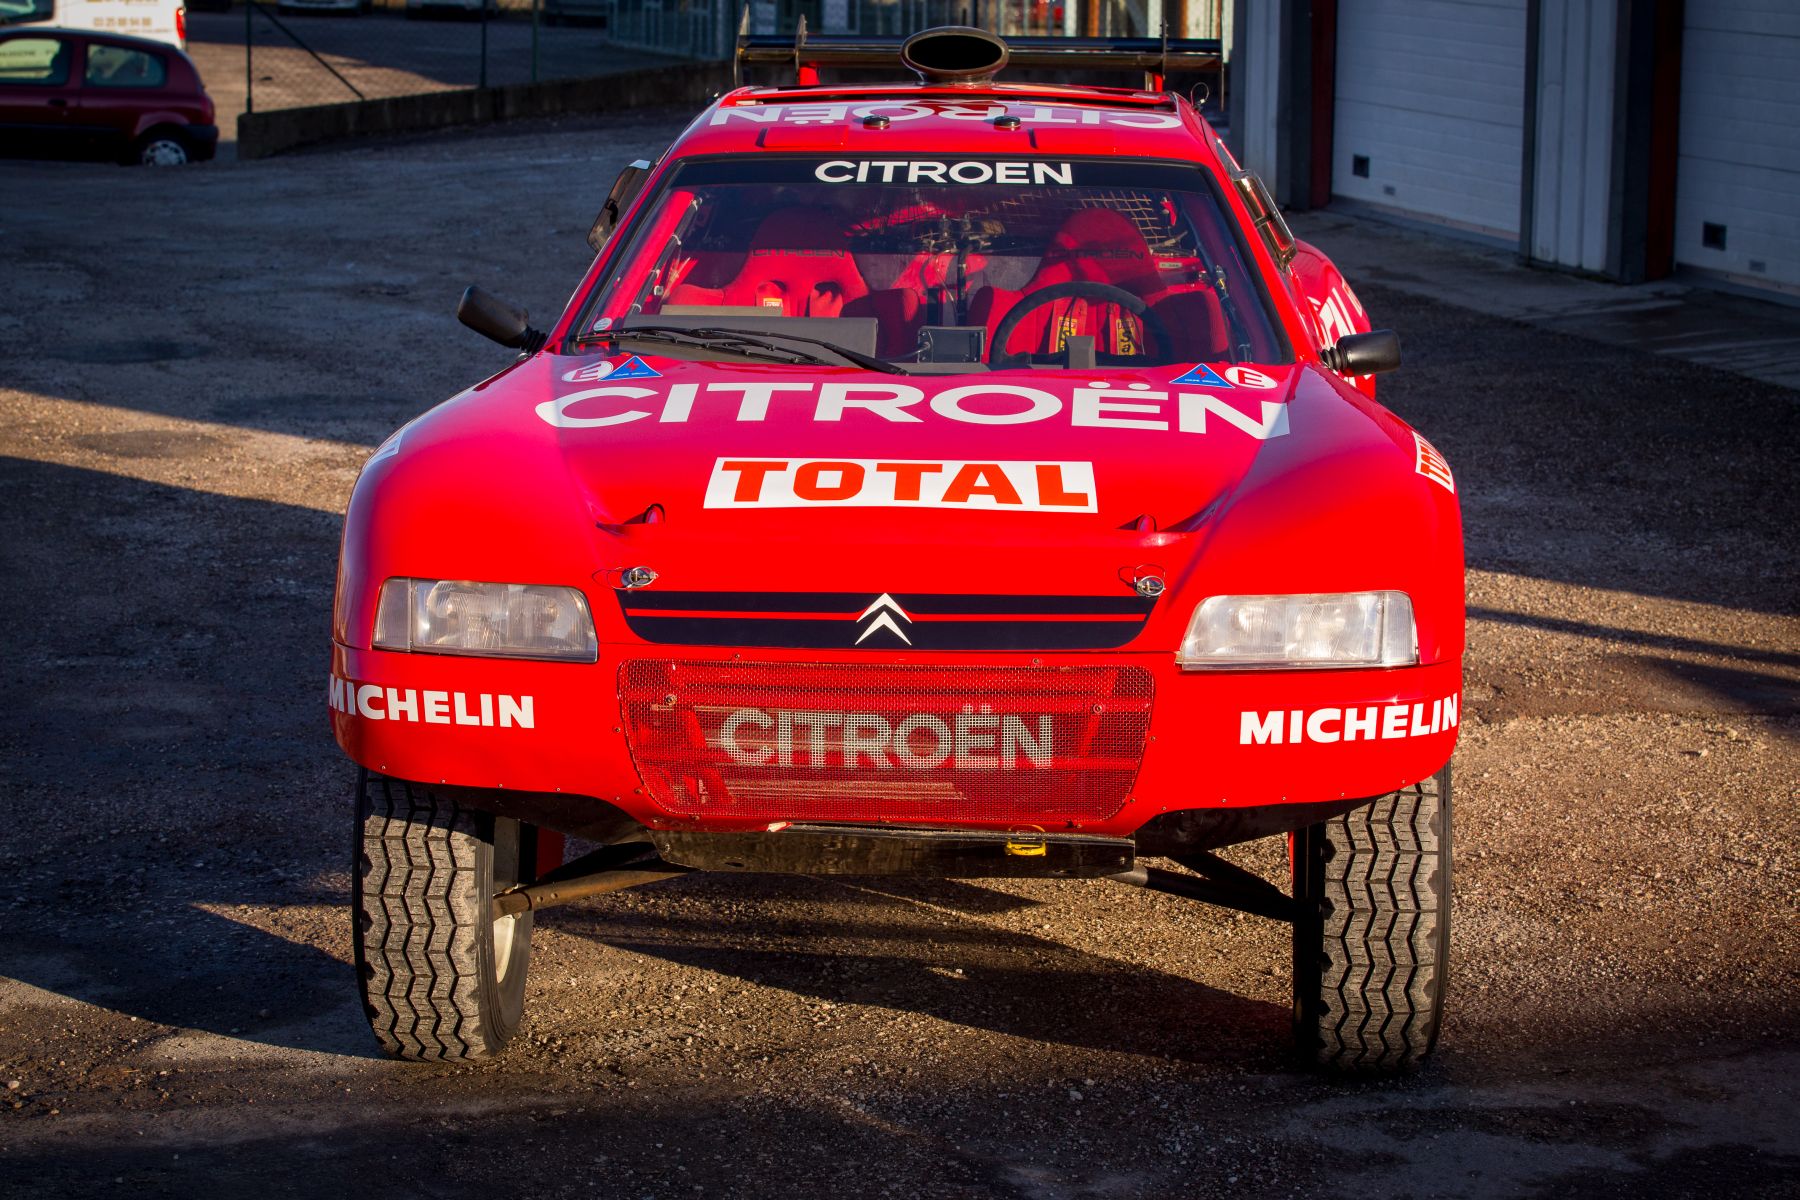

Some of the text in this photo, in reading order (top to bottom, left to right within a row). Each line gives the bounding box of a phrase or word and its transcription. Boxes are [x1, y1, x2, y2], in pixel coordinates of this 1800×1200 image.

[814, 160, 1074, 185] CITROEN
[535, 382, 1291, 439] CITROËN
[722, 460, 1089, 508] TOTAL
[329, 673, 535, 729] MICHELIN
[1239, 692, 1458, 745] MICHELIN
[720, 703, 1053, 770] CITROËN
